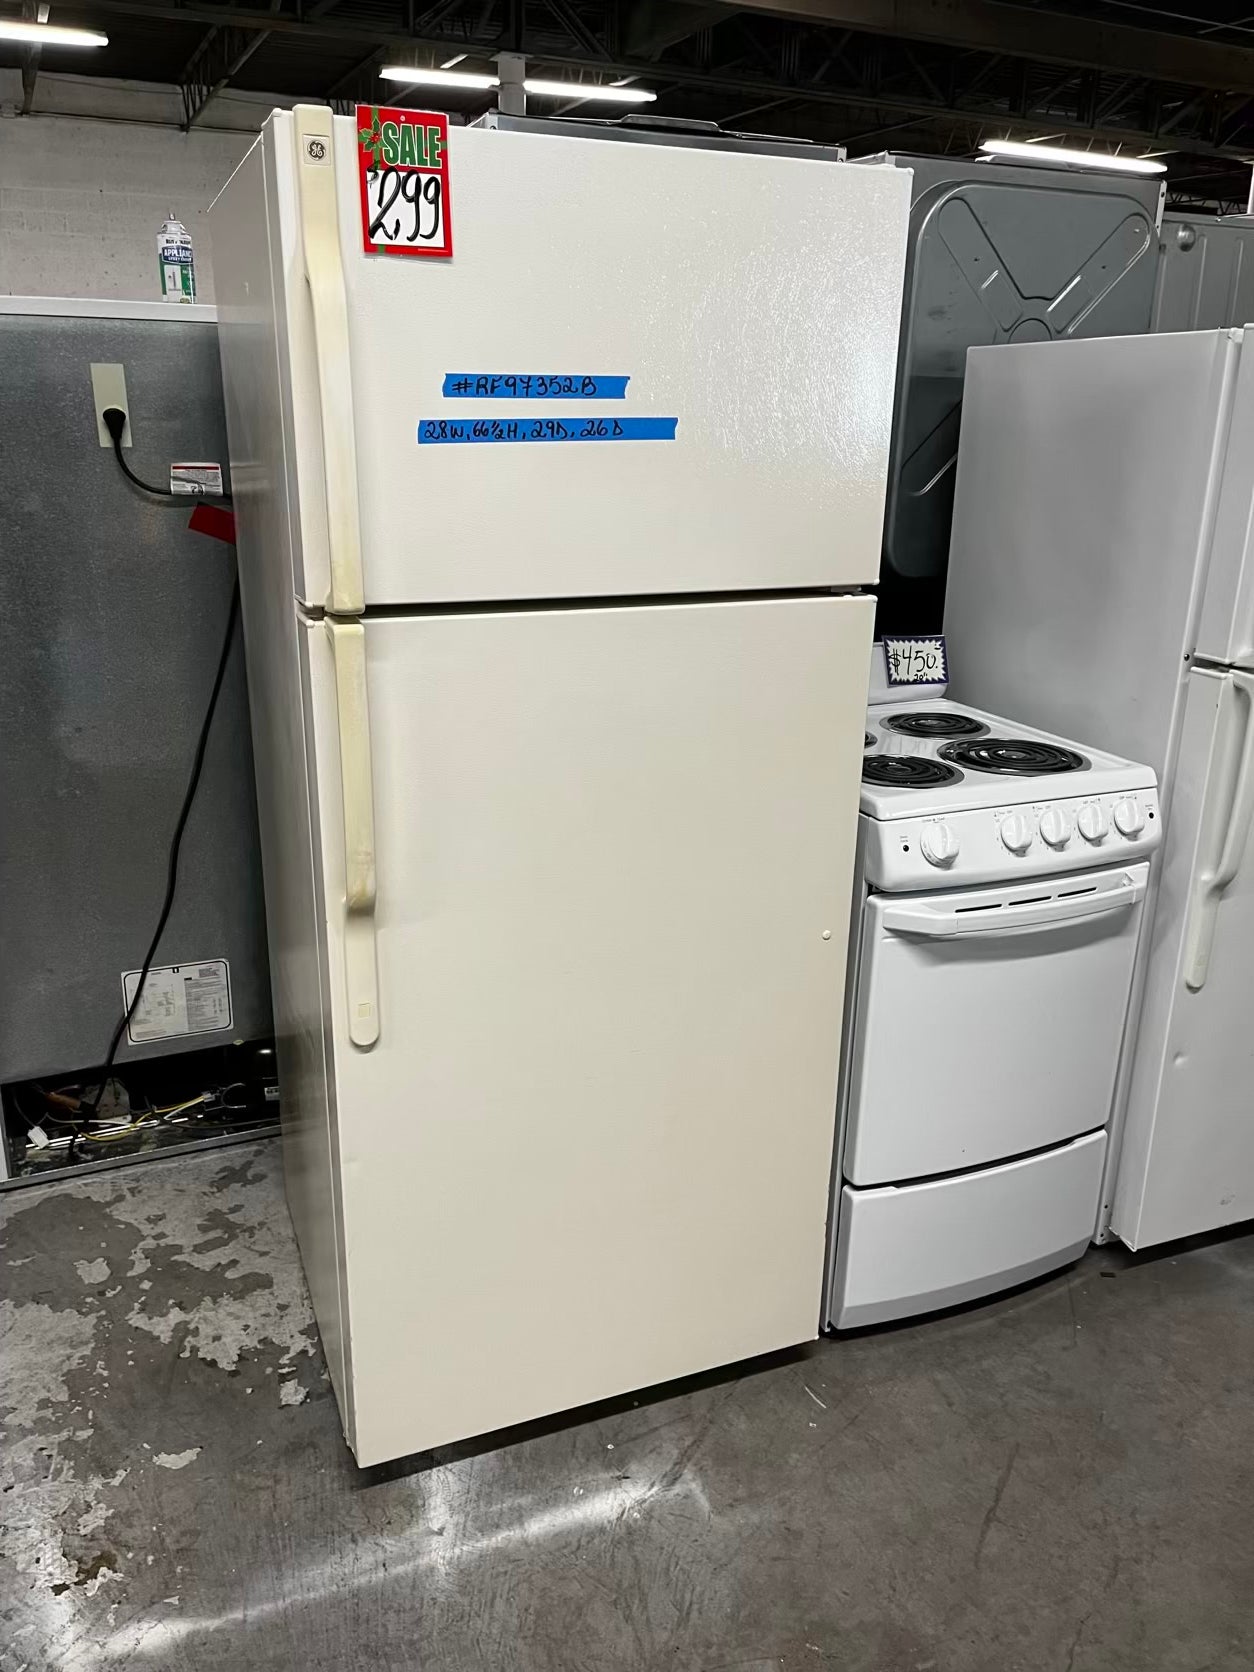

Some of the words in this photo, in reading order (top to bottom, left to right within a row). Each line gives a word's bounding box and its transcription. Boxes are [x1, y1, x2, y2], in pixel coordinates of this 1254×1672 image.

[381, 121, 443, 168] SALE
[164, 248, 193, 258] APPLIANC
[452, 375, 597, 396] #RF97352B
